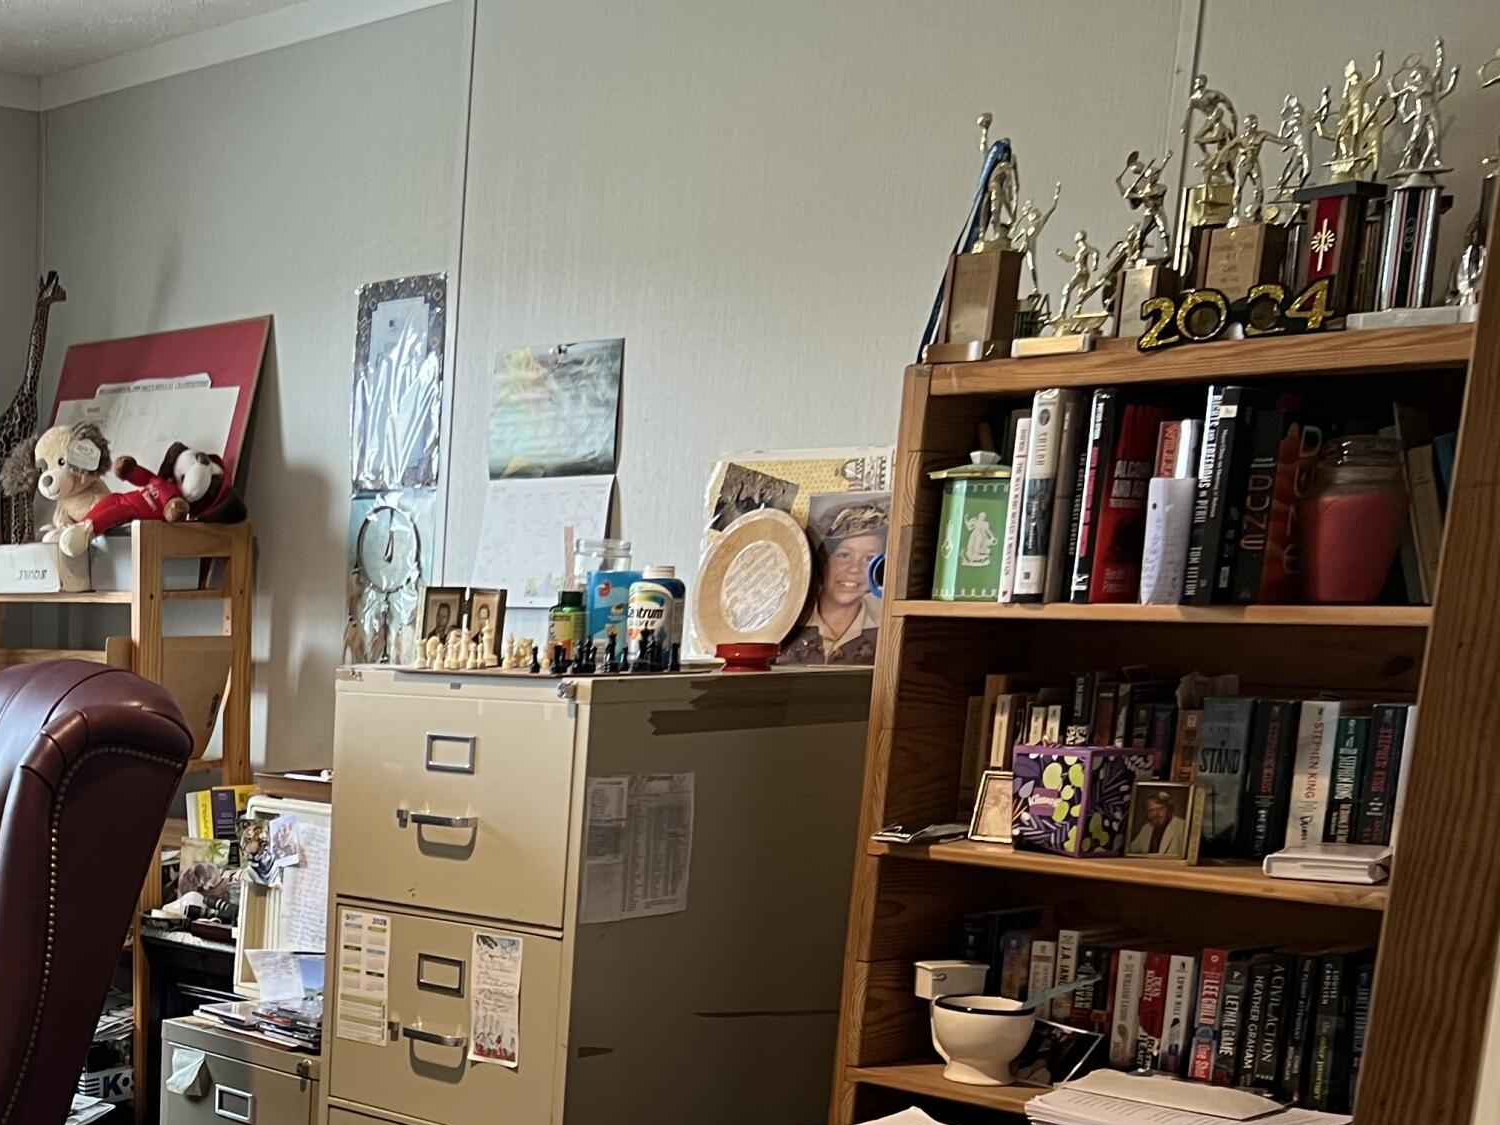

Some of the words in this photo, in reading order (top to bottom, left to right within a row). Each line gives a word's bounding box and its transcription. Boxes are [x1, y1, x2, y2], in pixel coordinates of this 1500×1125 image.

[1193, 499, 1209, 524] PERIL
[1187, 546, 1203, 564] TOM
[1184, 566, 1200, 597] FITTON
[1306, 722, 1324, 769] STEPHEN
[1199, 747, 1241, 774] STAND
[1304, 772, 1316, 799] KING
[1058, 965, 1070, 987] JANC
[1273, 964, 1285, 973] A
[1143, 969, 1155, 1002] KOONTZ
[1153, 976, 1163, 998] DEAN
[1174, 976, 1185, 998] EDWIN
[1203, 979, 1221, 995] LEE
[1268, 975, 1285, 1009] CIVIL
[1321, 963, 1332, 1005] CANDLISH
[1330, 970, 1340, 999] LOUISE
[1199, 997, 1219, 1025] CHILD
[1222, 994, 1240, 1028] LETHAL
[1249, 975, 1265, 1021] HEATHER
[1218, 1029, 1236, 1056] GAME
[1242, 1023, 1257, 1069] GRAHAM
[1260, 1012, 1279, 1063] ACTION
[1197, 1044, 1210, 1059] One
[1195, 1060, 1209, 1078] Shot
